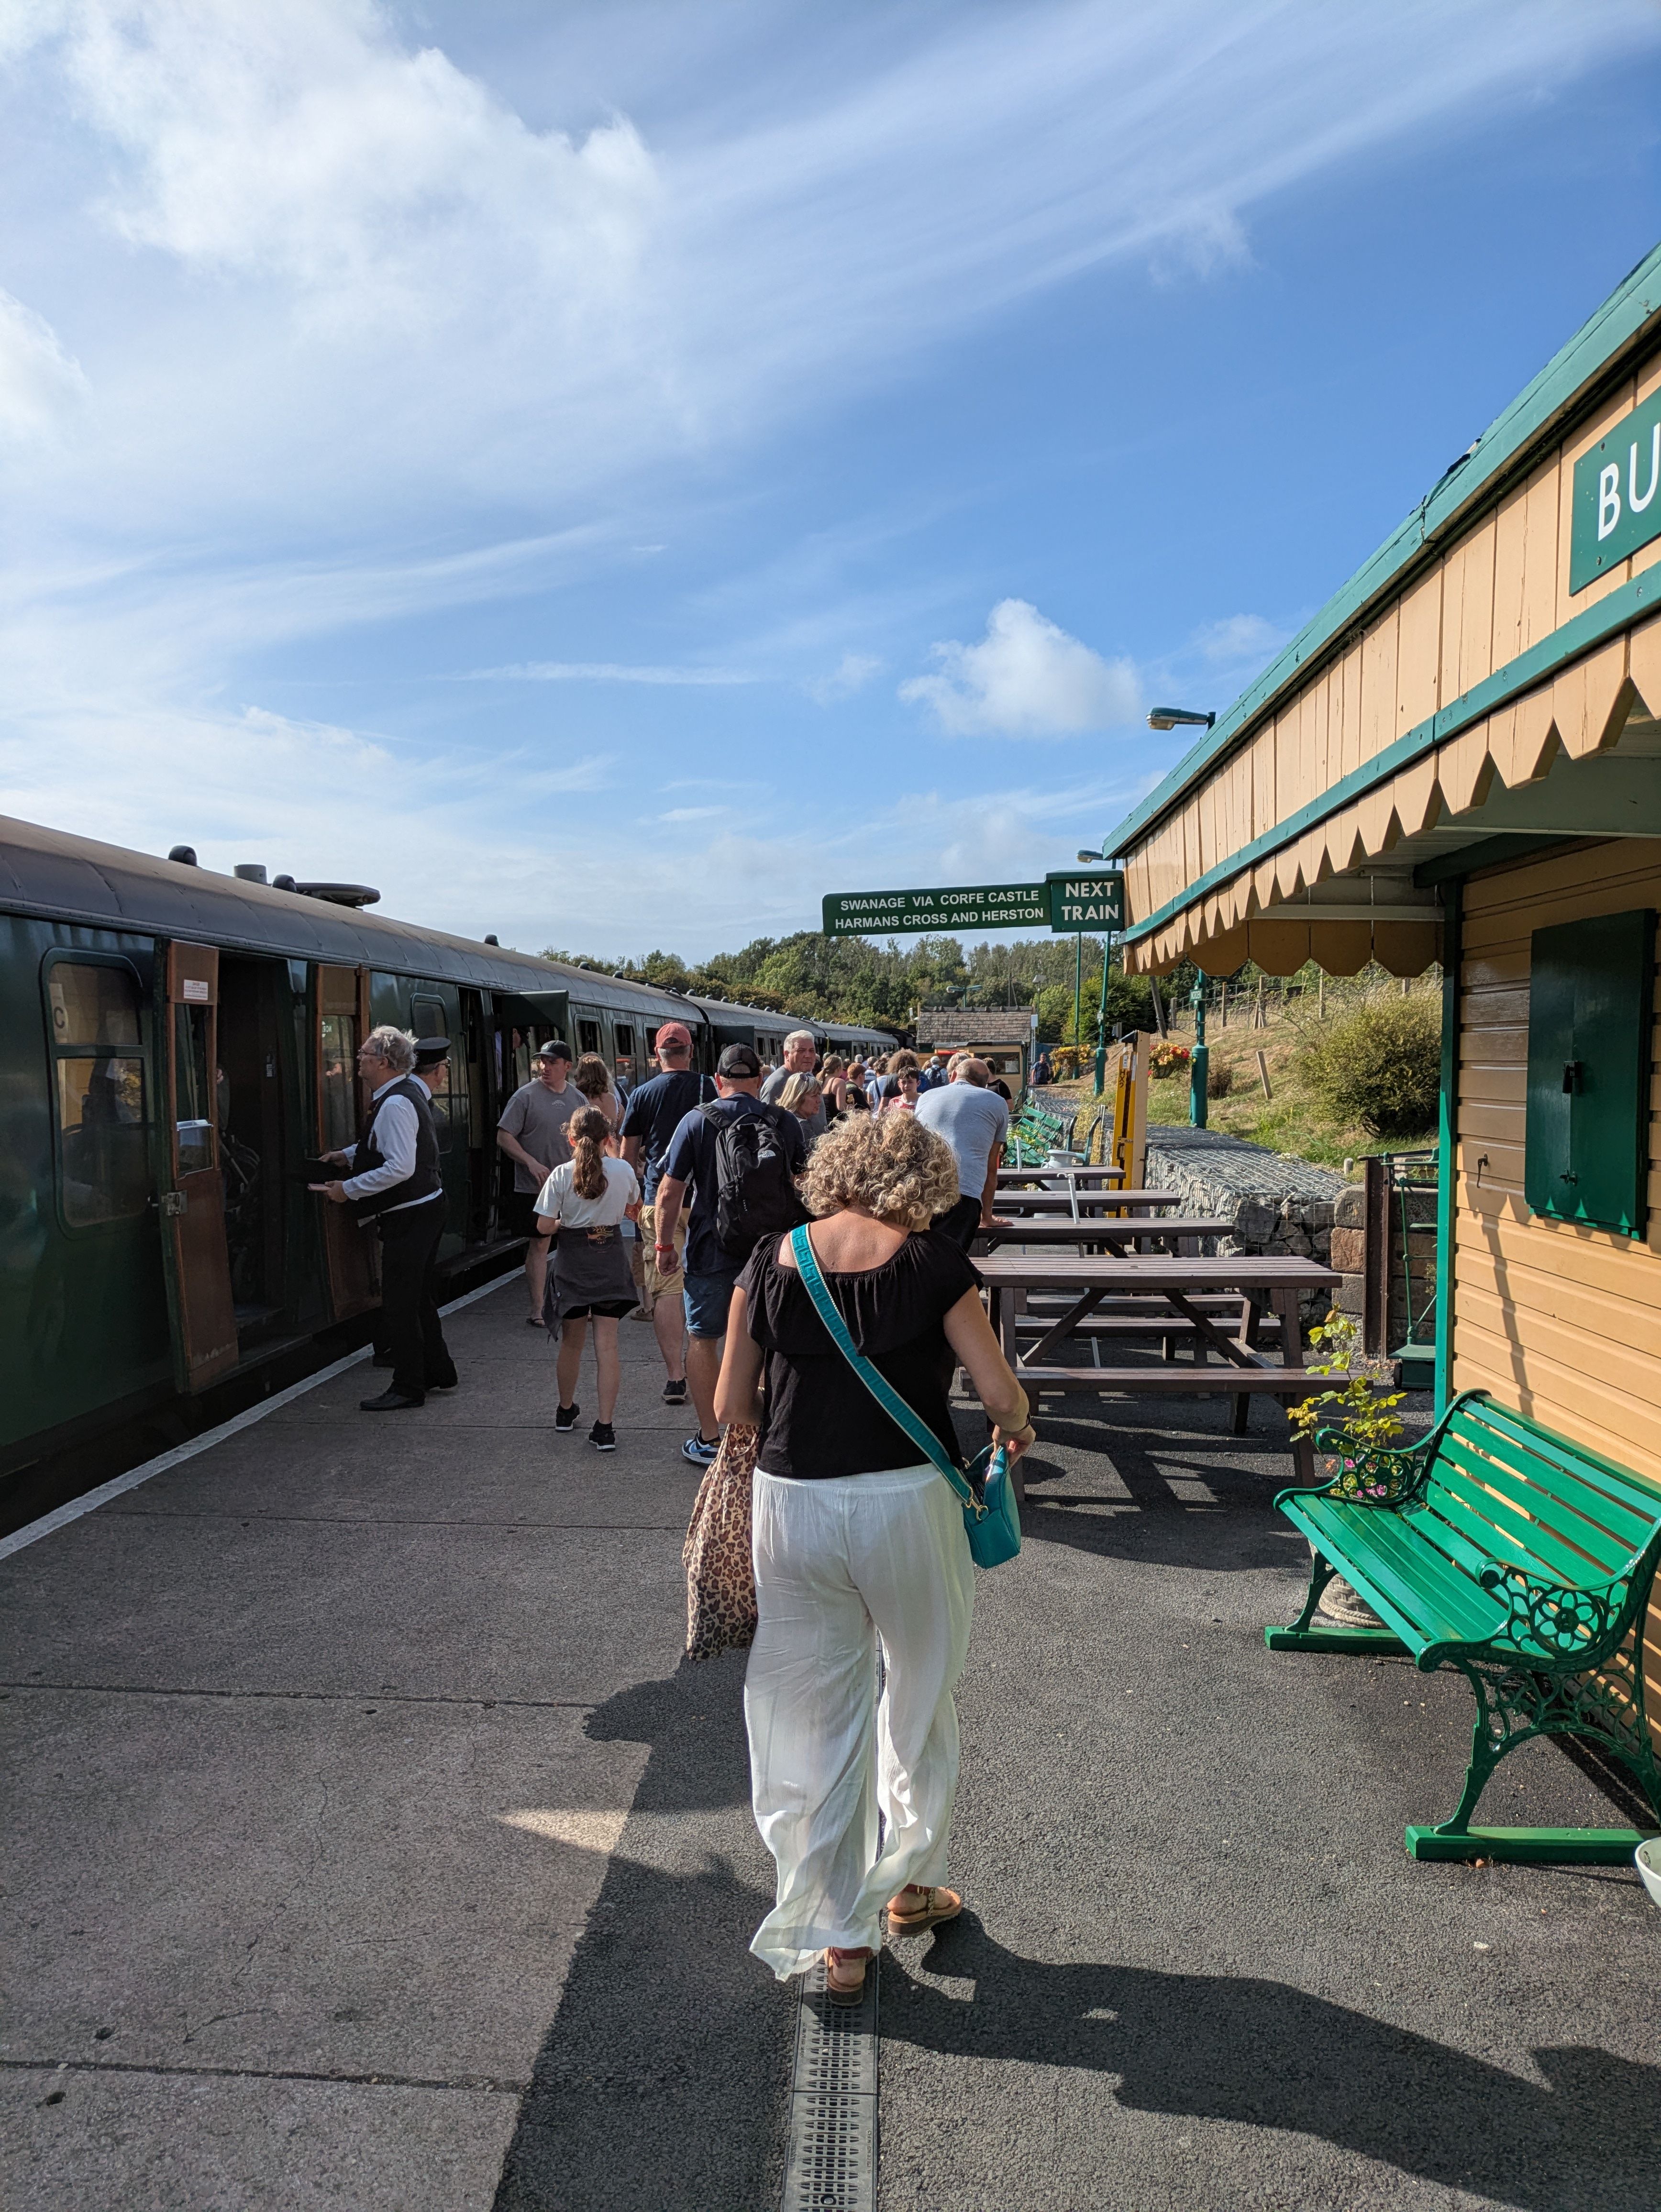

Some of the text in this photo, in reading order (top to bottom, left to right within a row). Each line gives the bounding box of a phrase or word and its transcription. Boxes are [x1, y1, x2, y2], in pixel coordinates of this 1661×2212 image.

[1598, 422, 1661, 541] BU
[1066, 882, 1114, 897] NEXT
[841, 890, 1039, 911] SWANAGE VIA CORFE CASTLE
[835, 907, 1043, 929] HARMANS CROSS AND HERSTON
[1061, 904, 1119, 920] TRAIN
